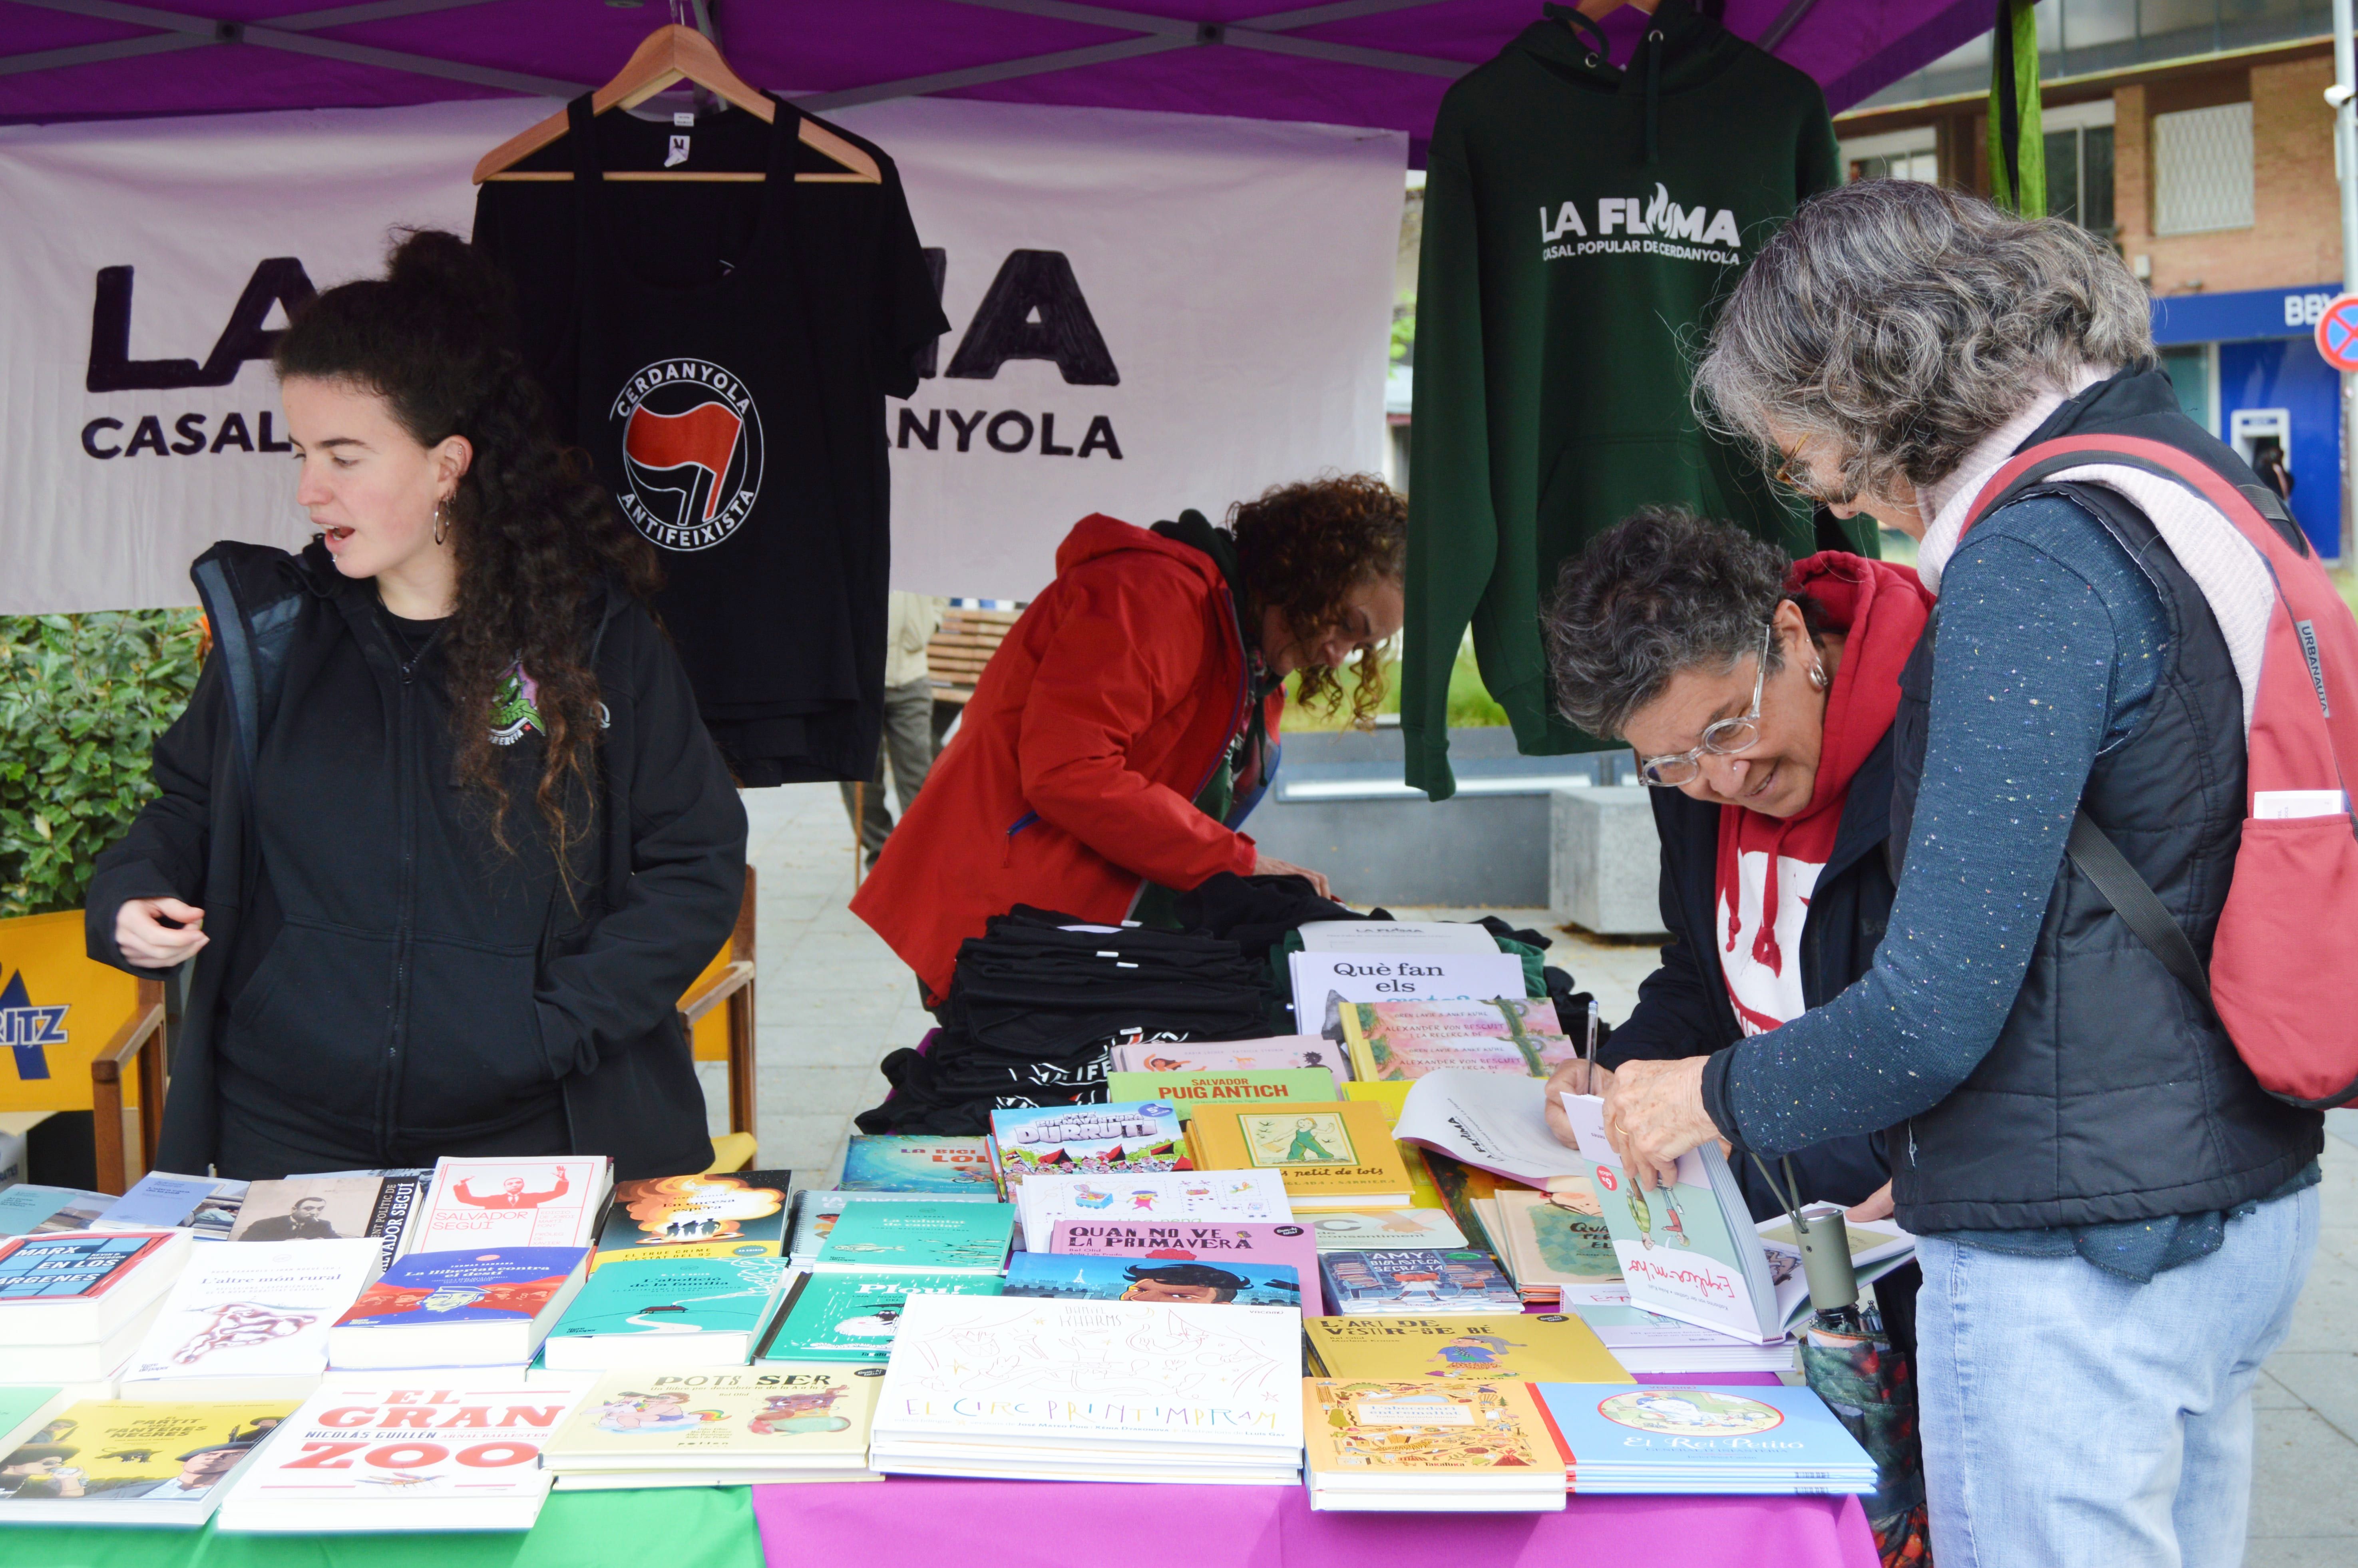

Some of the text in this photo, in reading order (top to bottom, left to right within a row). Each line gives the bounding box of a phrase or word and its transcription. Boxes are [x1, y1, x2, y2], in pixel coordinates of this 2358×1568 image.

[1540, 201, 1587, 243] LA
[1543, 240, 1740, 265] CASAL POPULAR DE CERDANYOLA
[86, 256, 318, 393] LA
[617, 362, 750, 417] CERDANYOLA
[82, 408, 1123, 460] CASAL NYOLA
[621, 490, 754, 547] ANTIFEIXISTA
[2301, 625, 2327, 712] URBANAUTA
[1333, 962, 1445, 977] Què fan
[1375, 979, 1416, 993] els
[1192, 1078, 1249, 1086] SALVADOR
[1158, 1084, 1289, 1099] PUIG ANTICH
[1035, 1114, 1144, 1128] BUENAVENTURA
[1015, 1119, 1158, 1144] DURRUTI
[1294, 1168, 1331, 1177] petit
[378, 1184, 396, 1223] POLÍTIC DE
[391, 1182, 414, 1217] SEGUÍ
[435, 1212, 528, 1221] SALVADOR
[1314, 1219, 1361, 1231] C
[1068, 1227, 1222, 1239] QUAN NO VE
[1067, 1237, 1254, 1249] LA PRIMAVERA
[15, 1246, 81, 1257] MARX
[37, 1259, 120, 1269] EN LOS
[428, 1267, 495, 1275] llibertat
[855, 1283, 961, 1295] Plou!
[1059, 1314, 1122, 1327] KHARMS
[1320, 1320, 1384, 1328] L'ART
[1325, 1325, 1495, 1336] VESTIR-SE BÉ
[651, 1375, 831, 1387] POTS SER
[382, 1389, 460, 1405] EL
[318, 1405, 566, 1428] GRAN
[906, 1397, 1276, 1429] EL CIRC PRINTIMPRAM
[304, 1429, 438, 1439] NICOLÁS GUILLÉN
[1623, 1436, 1804, 1449] El Rei Petitó
[279, 1441, 541, 1469] ZOO
